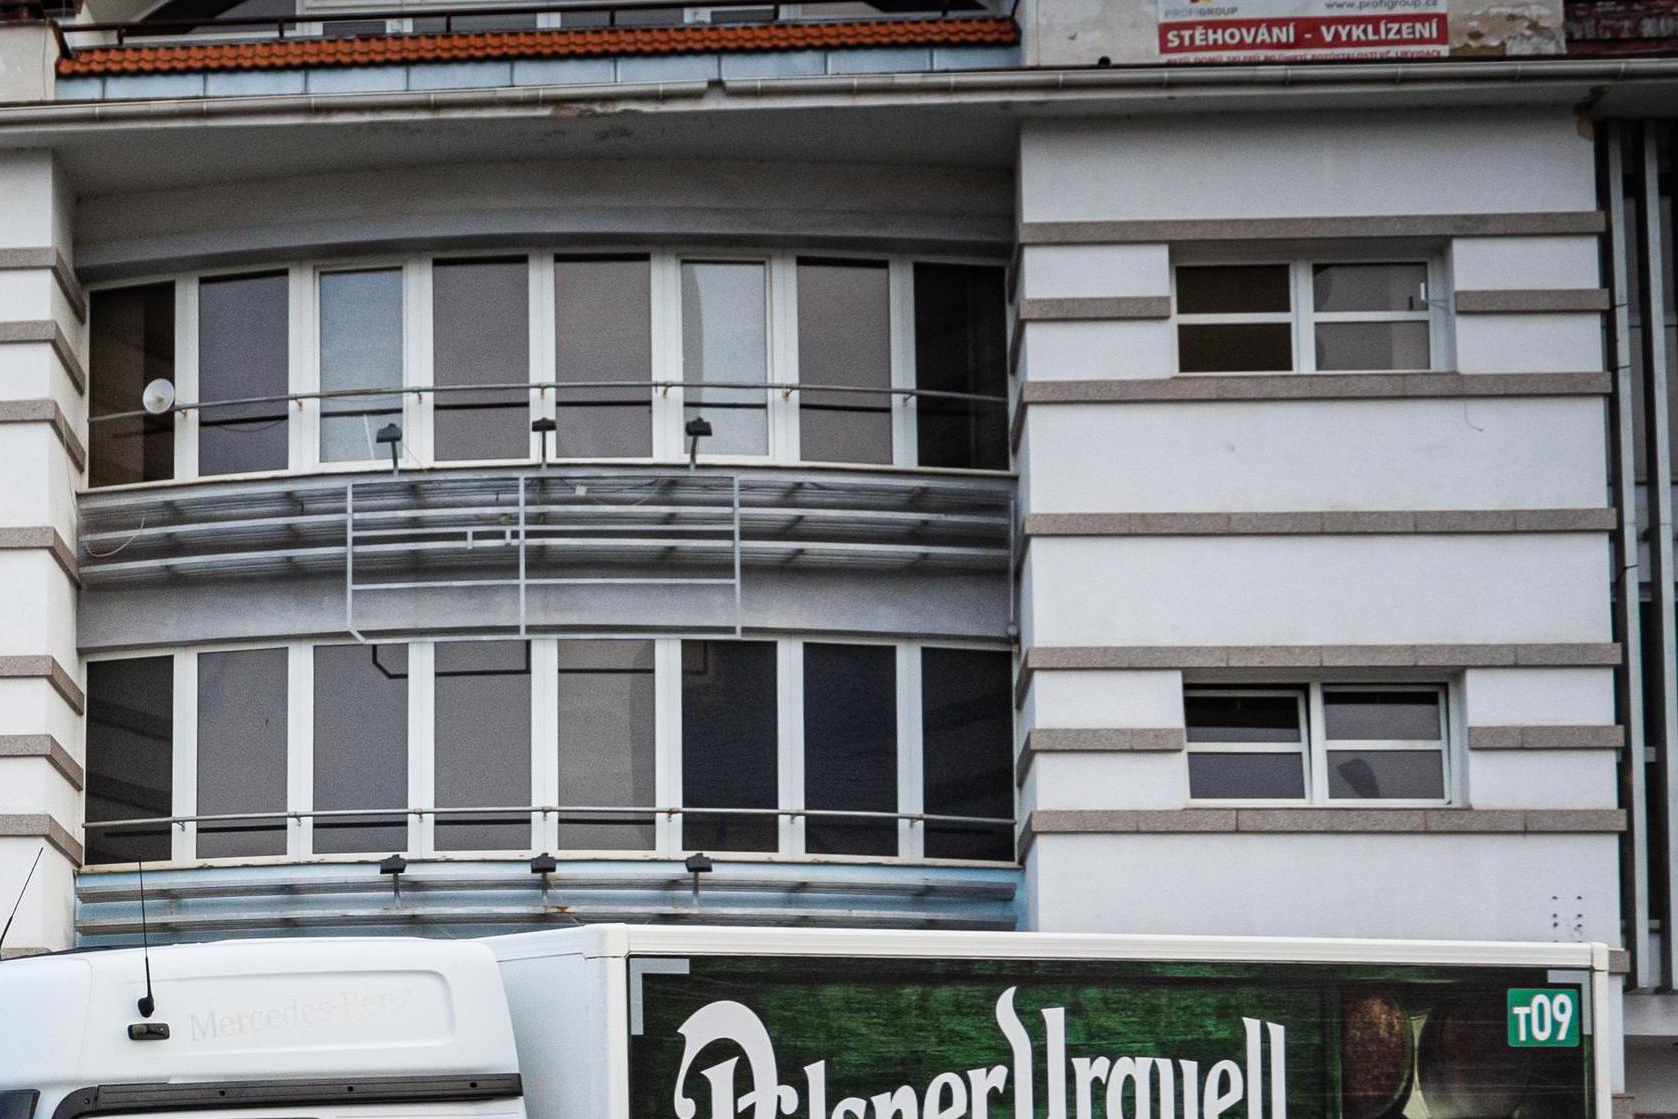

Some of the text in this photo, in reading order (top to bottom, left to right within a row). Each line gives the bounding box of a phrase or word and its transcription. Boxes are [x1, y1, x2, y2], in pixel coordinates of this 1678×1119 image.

[1166, 22, 1295, 48] STĚHOVÁNÍ
[1320, 18, 1438, 42] VYKLÍZENÍ
[1512, 993, 1572, 1042] T09
